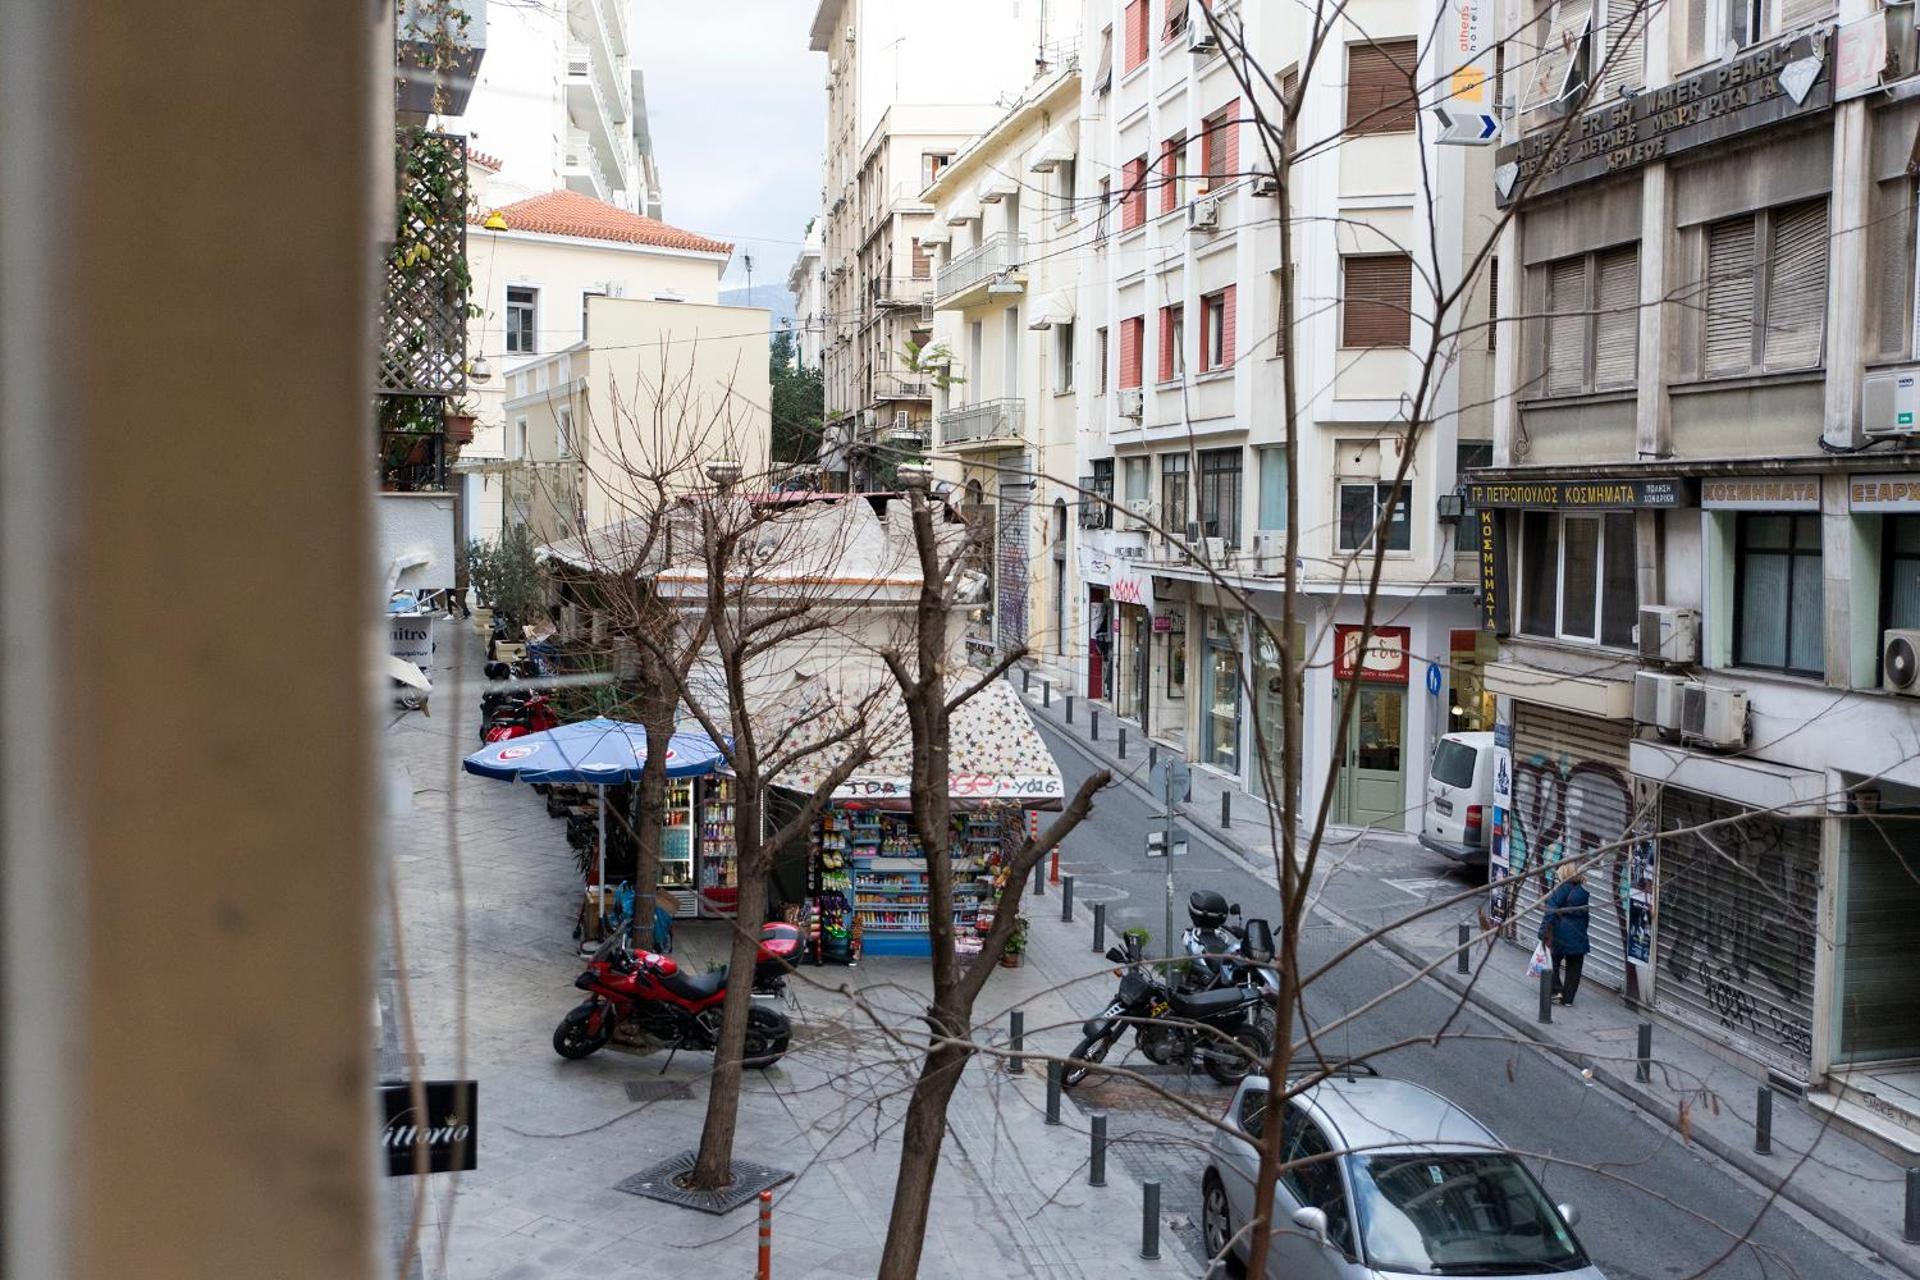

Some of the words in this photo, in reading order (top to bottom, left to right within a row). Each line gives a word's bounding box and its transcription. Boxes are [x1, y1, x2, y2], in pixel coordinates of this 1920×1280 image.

[1459, 5, 1470, 52] athens
[1648, 79, 1702, 112] WATER
[1486, 486, 1558, 503] ΠΕΤΡΟΠΟΥΛΟΣ
[1565, 485, 1635, 503] ΚΟΣΜΗΜΑΤΑ
[1703, 484, 1817, 501] ΚΟΣΜΗΜΑΤΑ
[1482, 511, 1495, 629] ΚΟΣΜΗΜΑΤΑ
